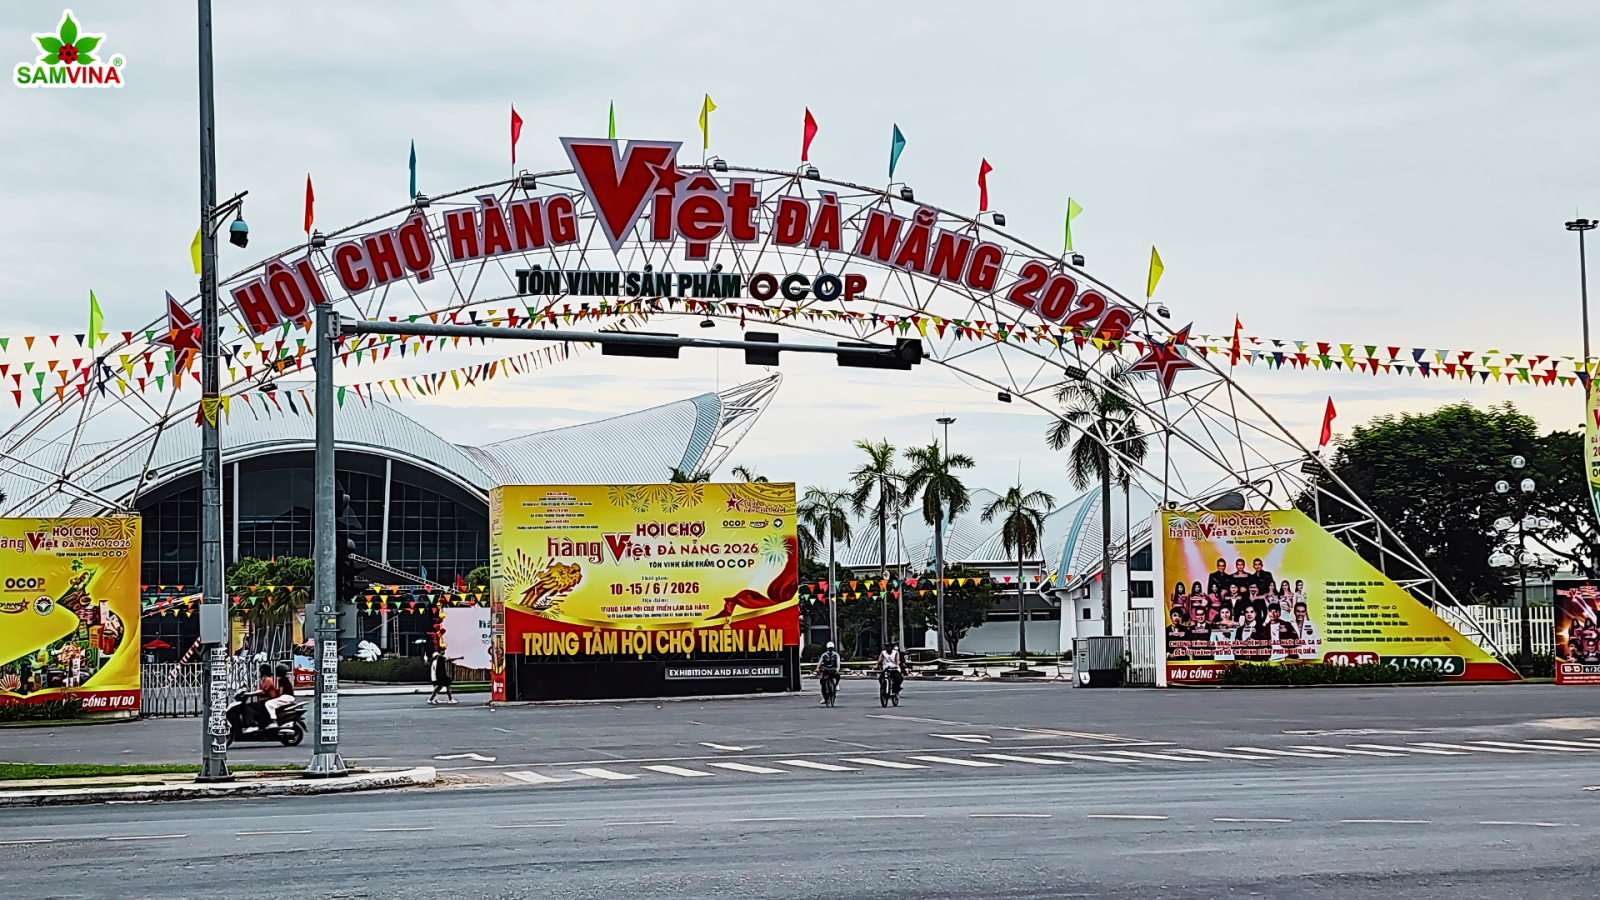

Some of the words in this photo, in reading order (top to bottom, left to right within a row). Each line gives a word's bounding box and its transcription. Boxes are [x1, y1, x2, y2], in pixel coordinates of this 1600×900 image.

[231, 255, 330, 337] HỘI
[334, 212, 435, 293] CHỢ
[445, 195, 578, 261] HÀNG
[562, 138, 760, 260] Việt
[773, 190, 842, 251] ĐÀ
[858, 206, 1003, 294] NẴNG
[1007, 260, 1132, 350] 2026
[516, 264, 560, 296] TÔN
[568, 269, 624, 297] VINH
[626, 264, 673, 297] SẢN
[679, 263, 741, 298] PHẨM
[750, 273, 867, 302] OCOP
[53, 527, 72, 538] HỘI
[74, 527, 100, 538] CHỢ
[637, 520, 666, 538] HỘI
[667, 520, 705, 538] CHỢ
[1272, 528, 1295, 536] 2026
[24, 531, 59, 553] Việt
[62, 538, 75, 548] ĐÀ
[106, 539, 131, 548] 2026
[547, 535, 604, 564] hàng
[602, 533, 651, 565] Việt
[657, 541, 677, 556] ĐÀ
[680, 539, 720, 555] NẴNG
[723, 543, 759, 555] 2026
[716, 559, 755, 569] OCOP
[5, 577, 46, 589] OCOP
[670, 582, 700, 594] 2026
[522, 631, 580, 656] TRUNG
[583, 626, 618, 656] TÂM
[621, 625, 651, 660] HỘI
[655, 627, 695, 659] CHỢ
[699, 617, 744, 654] TRIỂN
[748, 624, 784, 653] LÃM
[669, 668, 713, 677] EXHIBITION
[714, 668, 731, 676] AND
[732, 667, 749, 676] FAIR
[750, 667, 780, 675] CENTER
[1171, 667, 1187, 679] VÀO
[122, 696, 135, 706] DO
